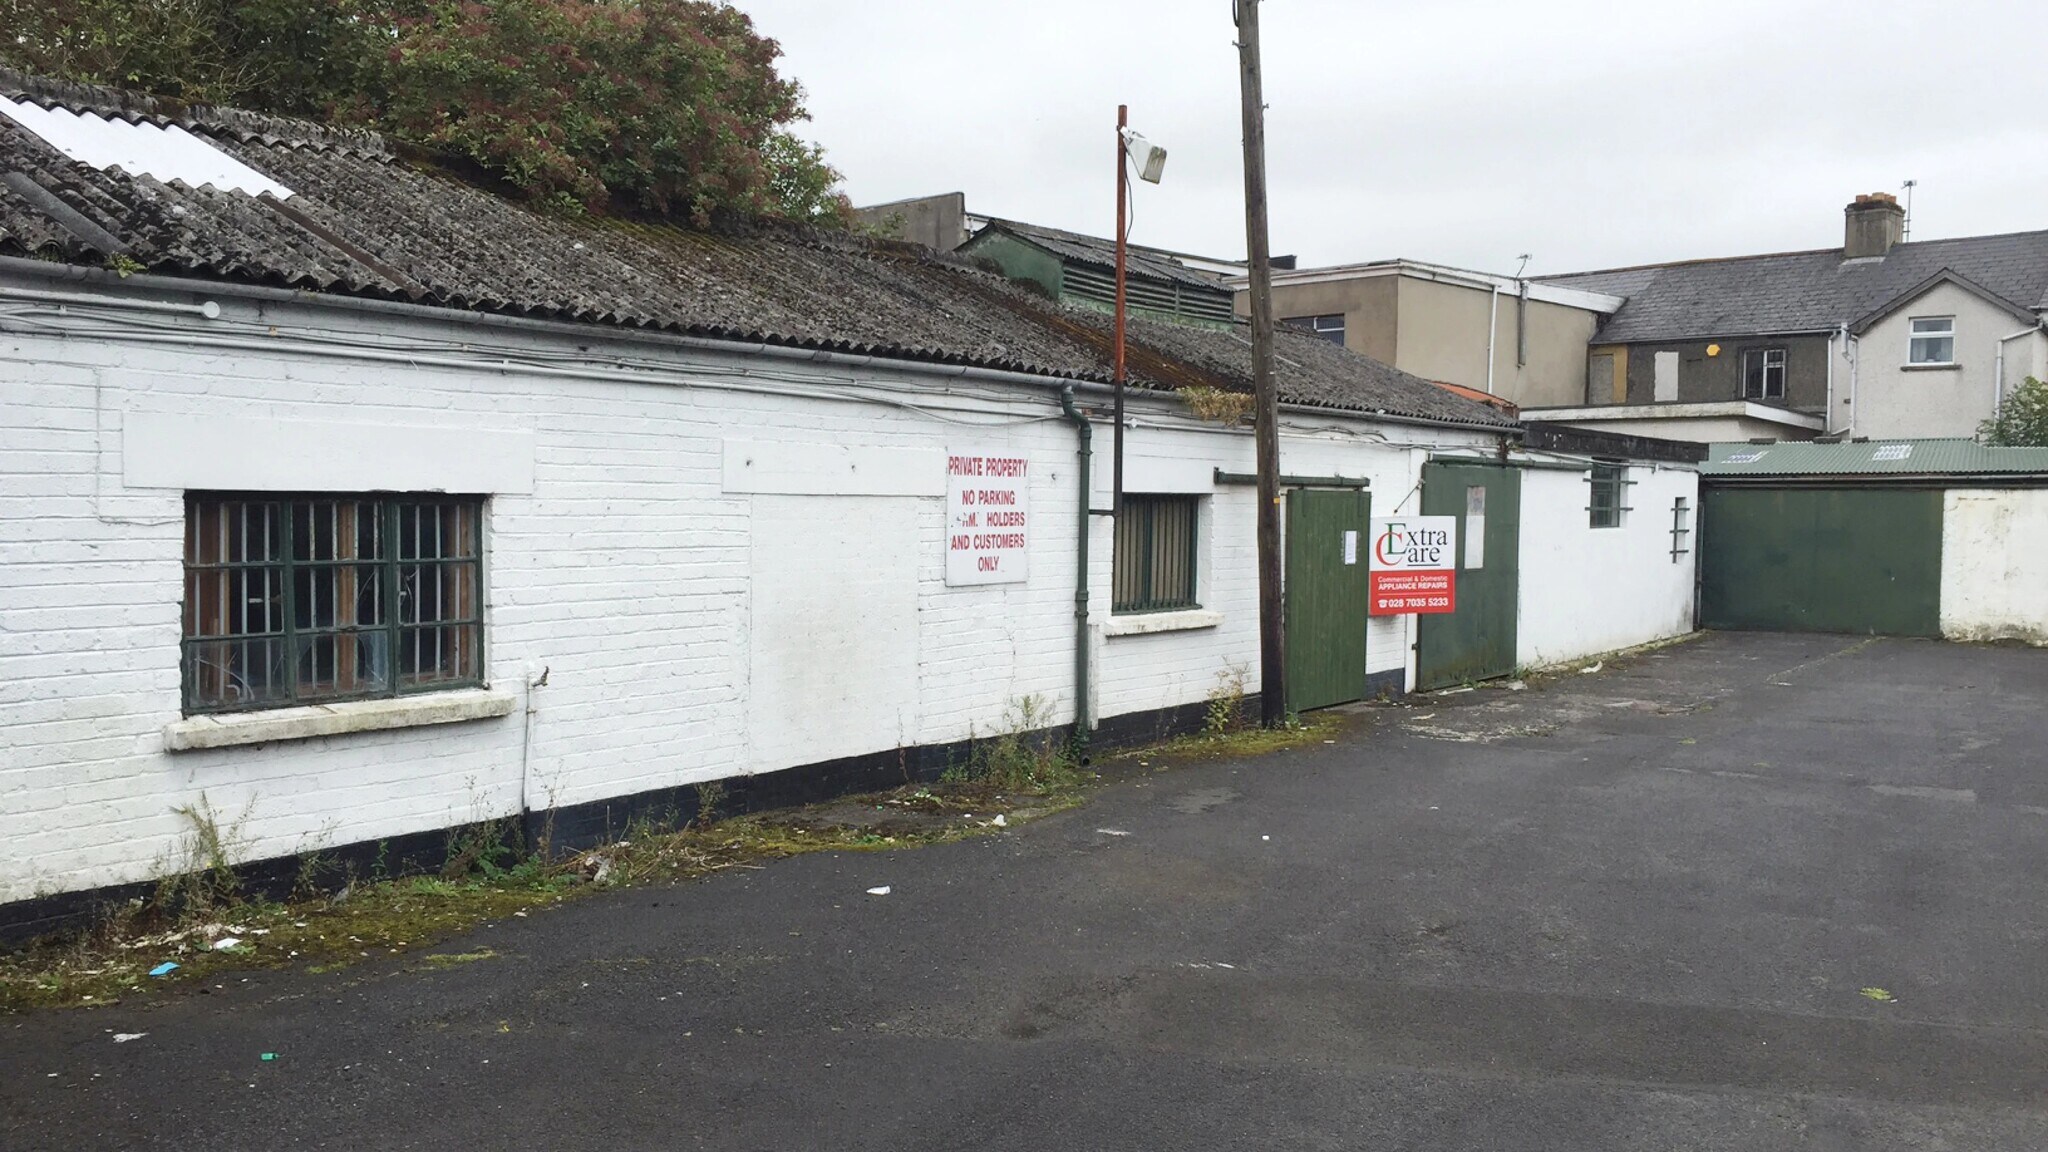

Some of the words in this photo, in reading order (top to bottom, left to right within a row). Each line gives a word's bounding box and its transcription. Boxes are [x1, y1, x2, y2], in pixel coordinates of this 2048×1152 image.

[948, 456, 983, 476] PRIVATE
[985, 458, 1028, 477] PROPERTY
[962, 489, 975, 505] NO
[978, 490, 1015, 505] PARKING
[986, 511, 1025, 527] HOLDERS
[950, 534, 970, 550] AND
[973, 533, 1025, 550] CUSTOMERS
[1384, 522, 1448, 555] Extra
[1375, 531, 1441, 566] Care
[978, 556, 999, 572] ONLY
[1378, 582, 1417, 590] APPLIANCE
[1417, 581, 1448, 589] REPAIRS
[1388, 598, 1404, 608] 028
[1406, 598, 1426, 607] 7035
[1427, 597, 1448, 606] 5233
